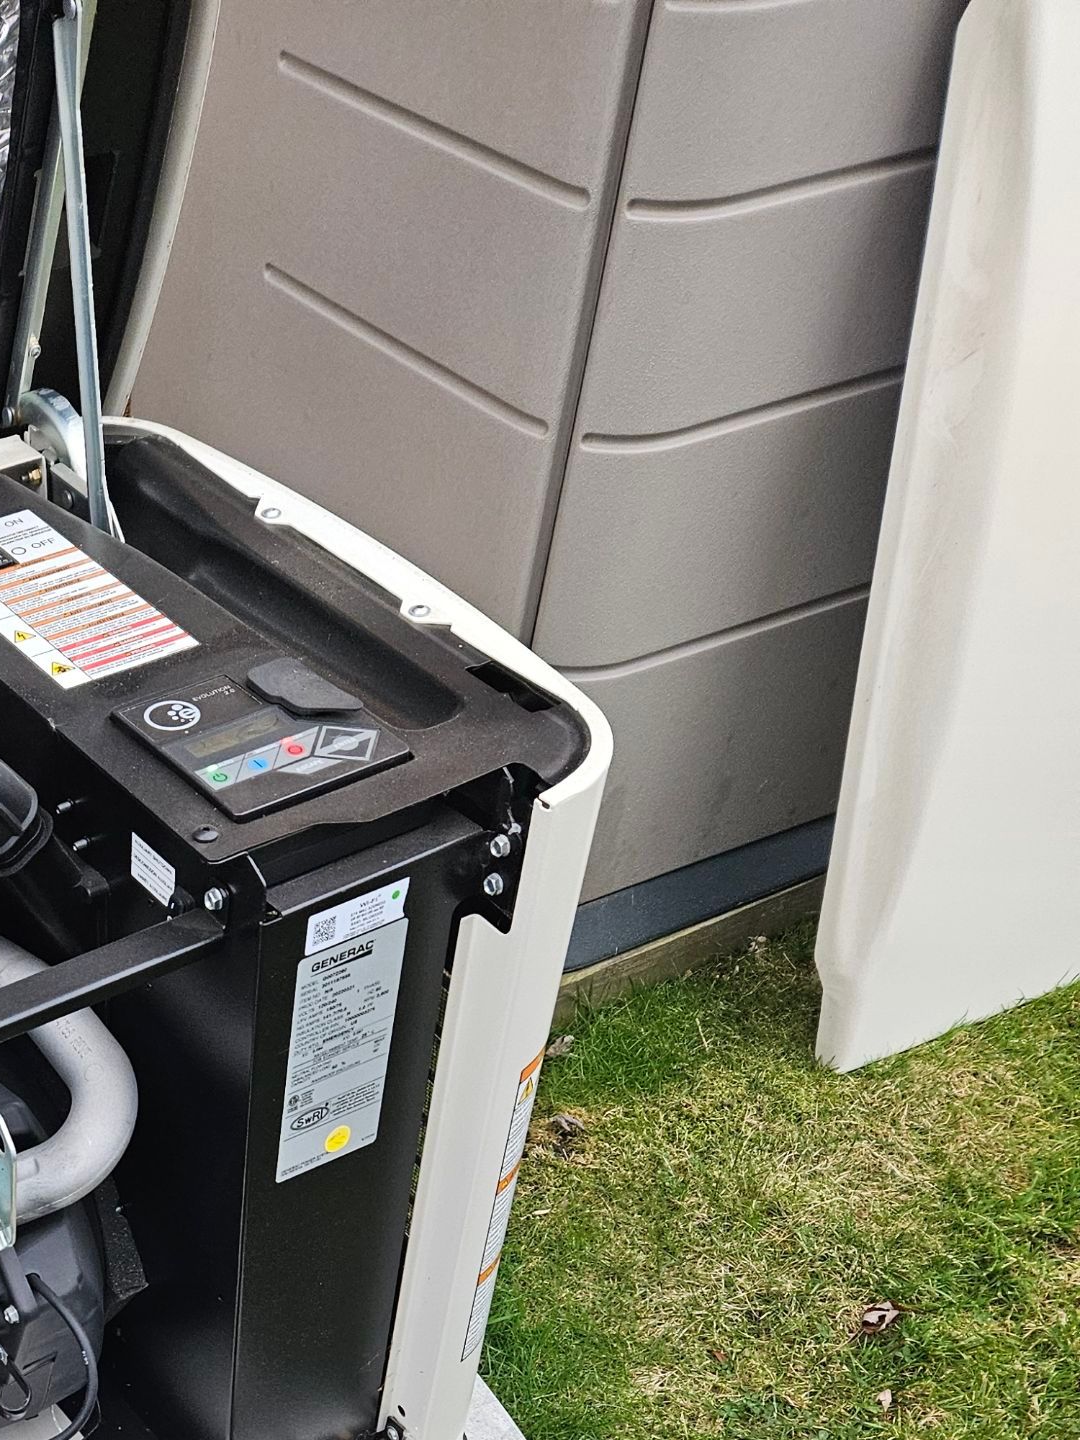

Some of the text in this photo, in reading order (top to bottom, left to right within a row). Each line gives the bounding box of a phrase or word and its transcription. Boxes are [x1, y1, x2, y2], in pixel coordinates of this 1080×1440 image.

[4, 518, 24, 528] ON
[31, 538, 56, 548] OFF
[192, 684, 231, 702] EVOLUTION
[312, 940, 374, 972] GENERAC
